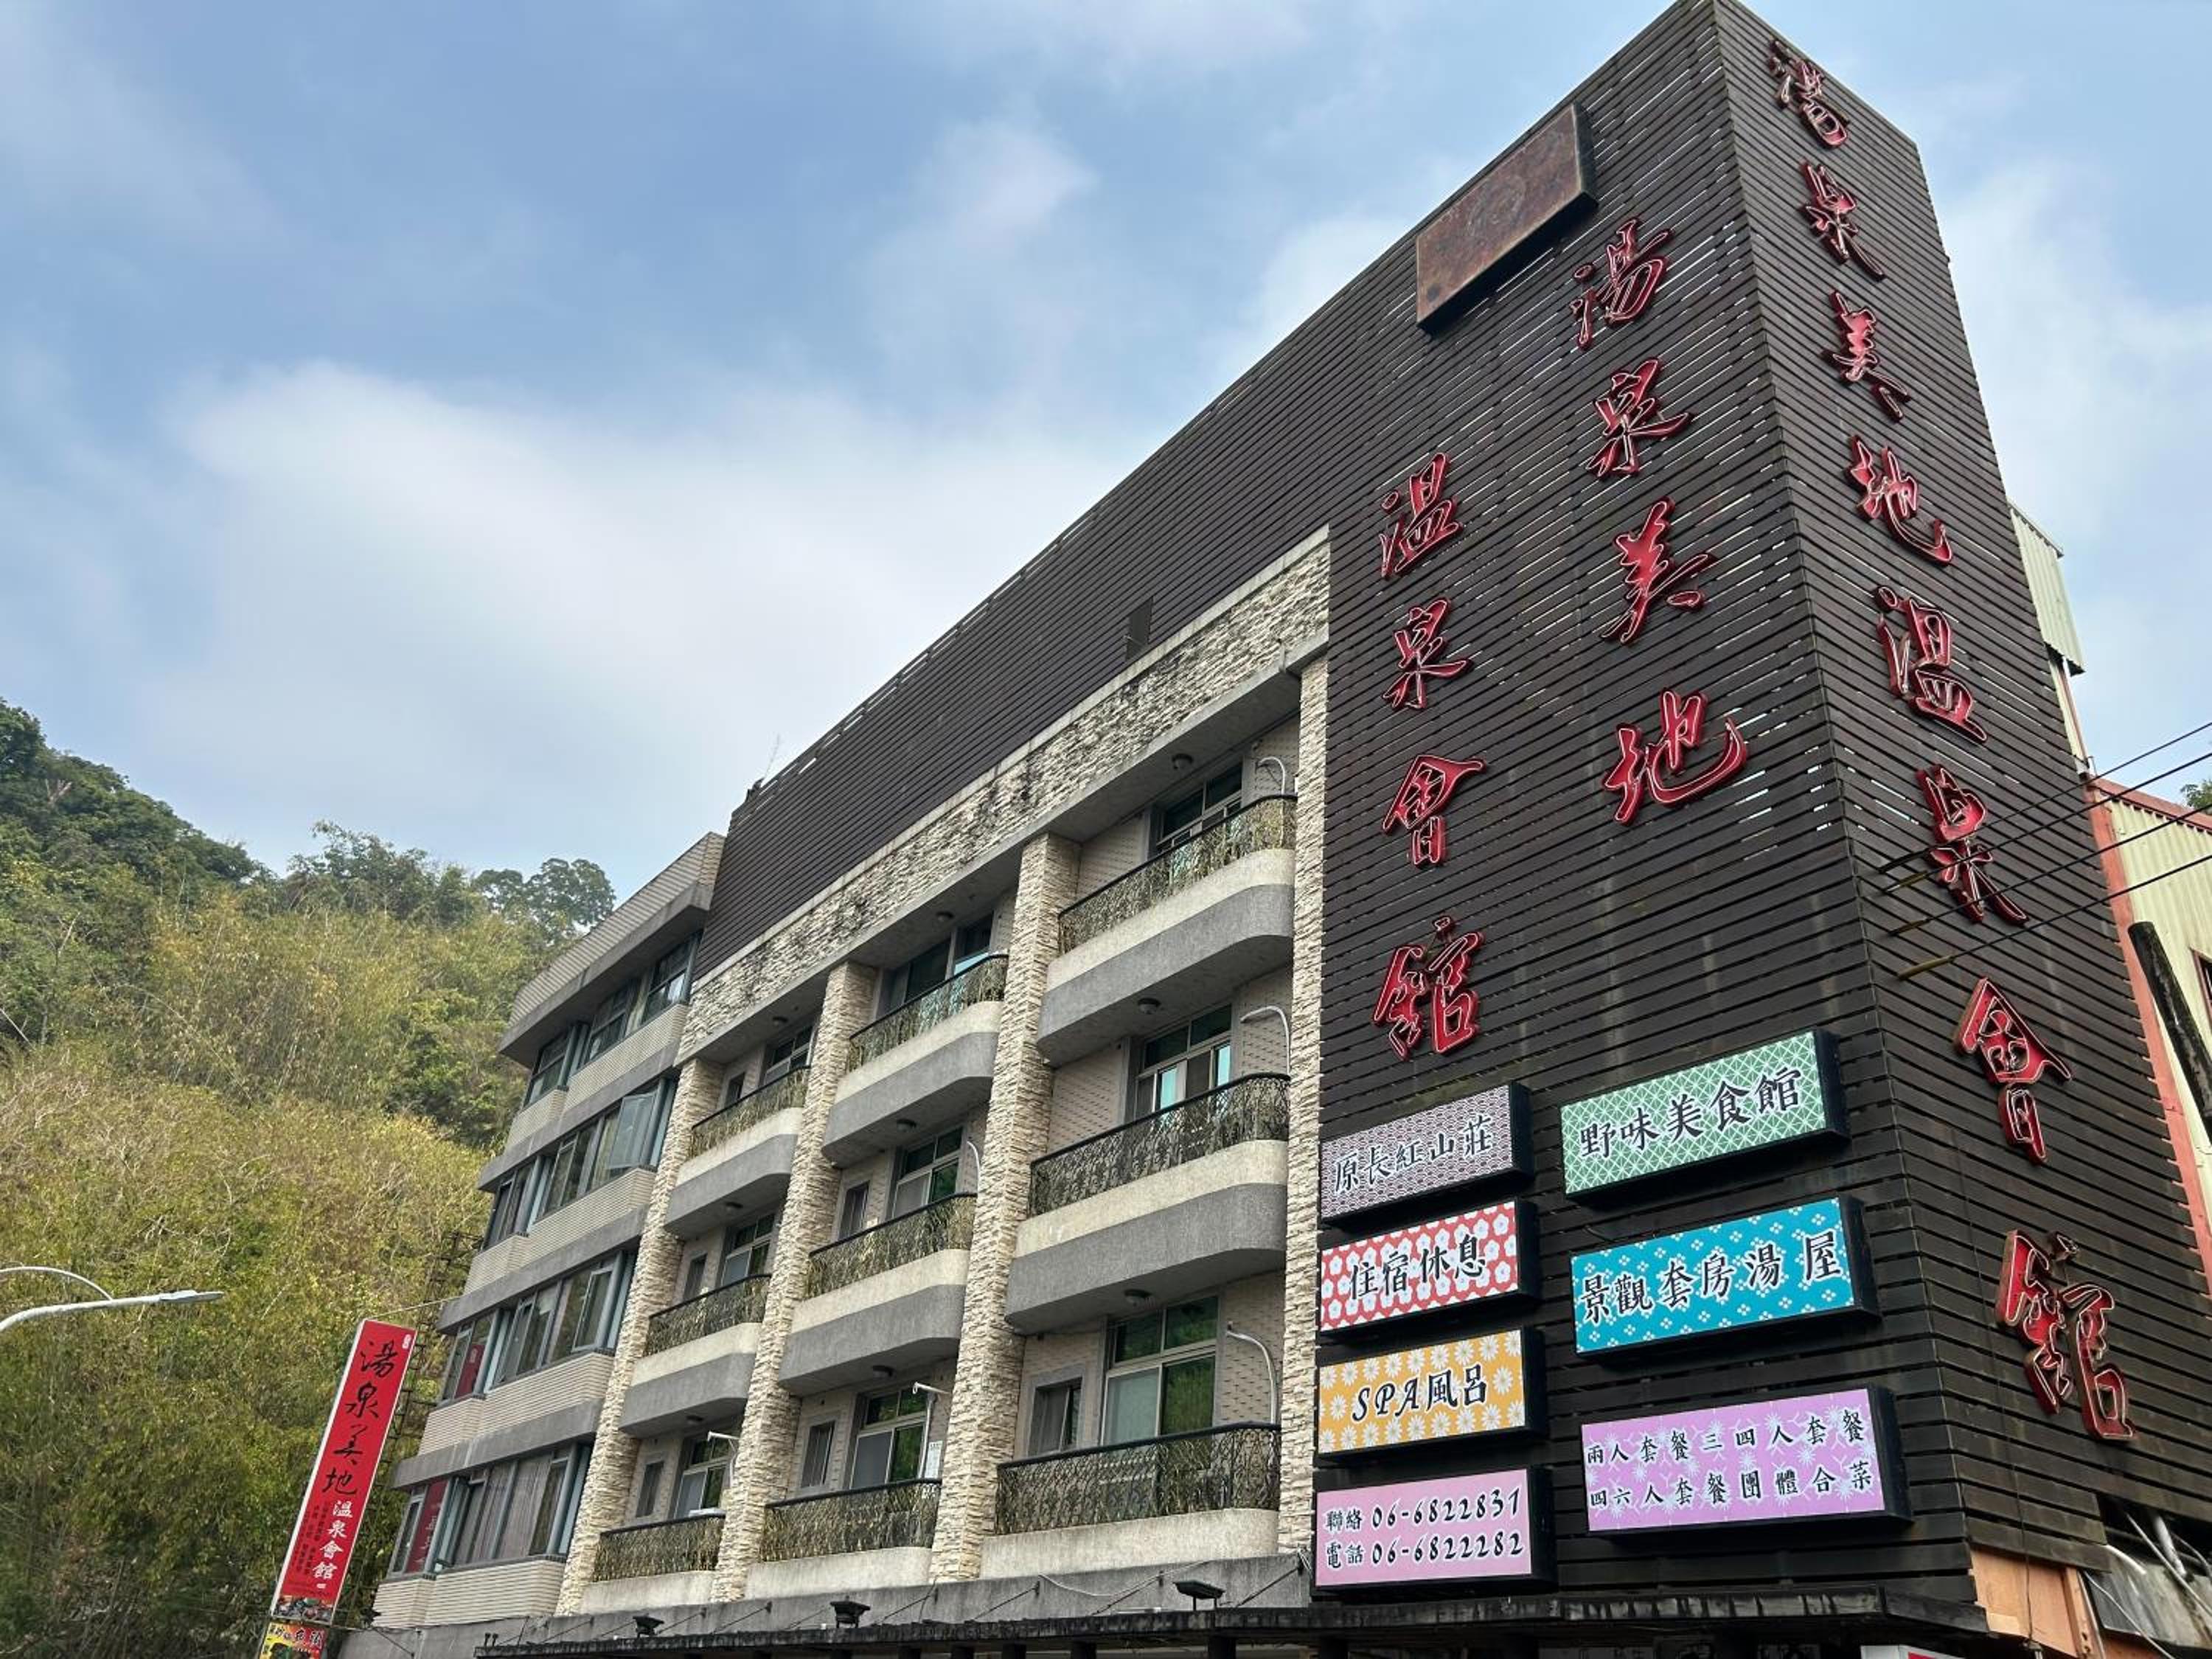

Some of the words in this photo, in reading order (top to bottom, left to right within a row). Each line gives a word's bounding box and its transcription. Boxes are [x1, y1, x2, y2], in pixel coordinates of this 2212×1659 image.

[1571, 215, 1748, 827] 湯泉美地
[1372, 451, 1487, 1061] 溫泉會館
[1579, 1066, 1802, 1158] 野味美食館
[1333, 1114, 1494, 1194] 原長紅山莊
[1349, 1233, 1487, 1301] 住宿休息
[1580, 1231, 1841, 1324] 景觀套房湯屋
[1352, 1363, 1487, 1422] SPA風呂
[313, 1500, 353, 1579] 溫泉會館
[1326, 1508, 1363, 1532] 聯絡
[1372, 1486, 1520, 1528] 06-6822831
[1324, 1541, 1365, 1569] 電話
[1372, 1531, 1524, 1565] 06-6822282
